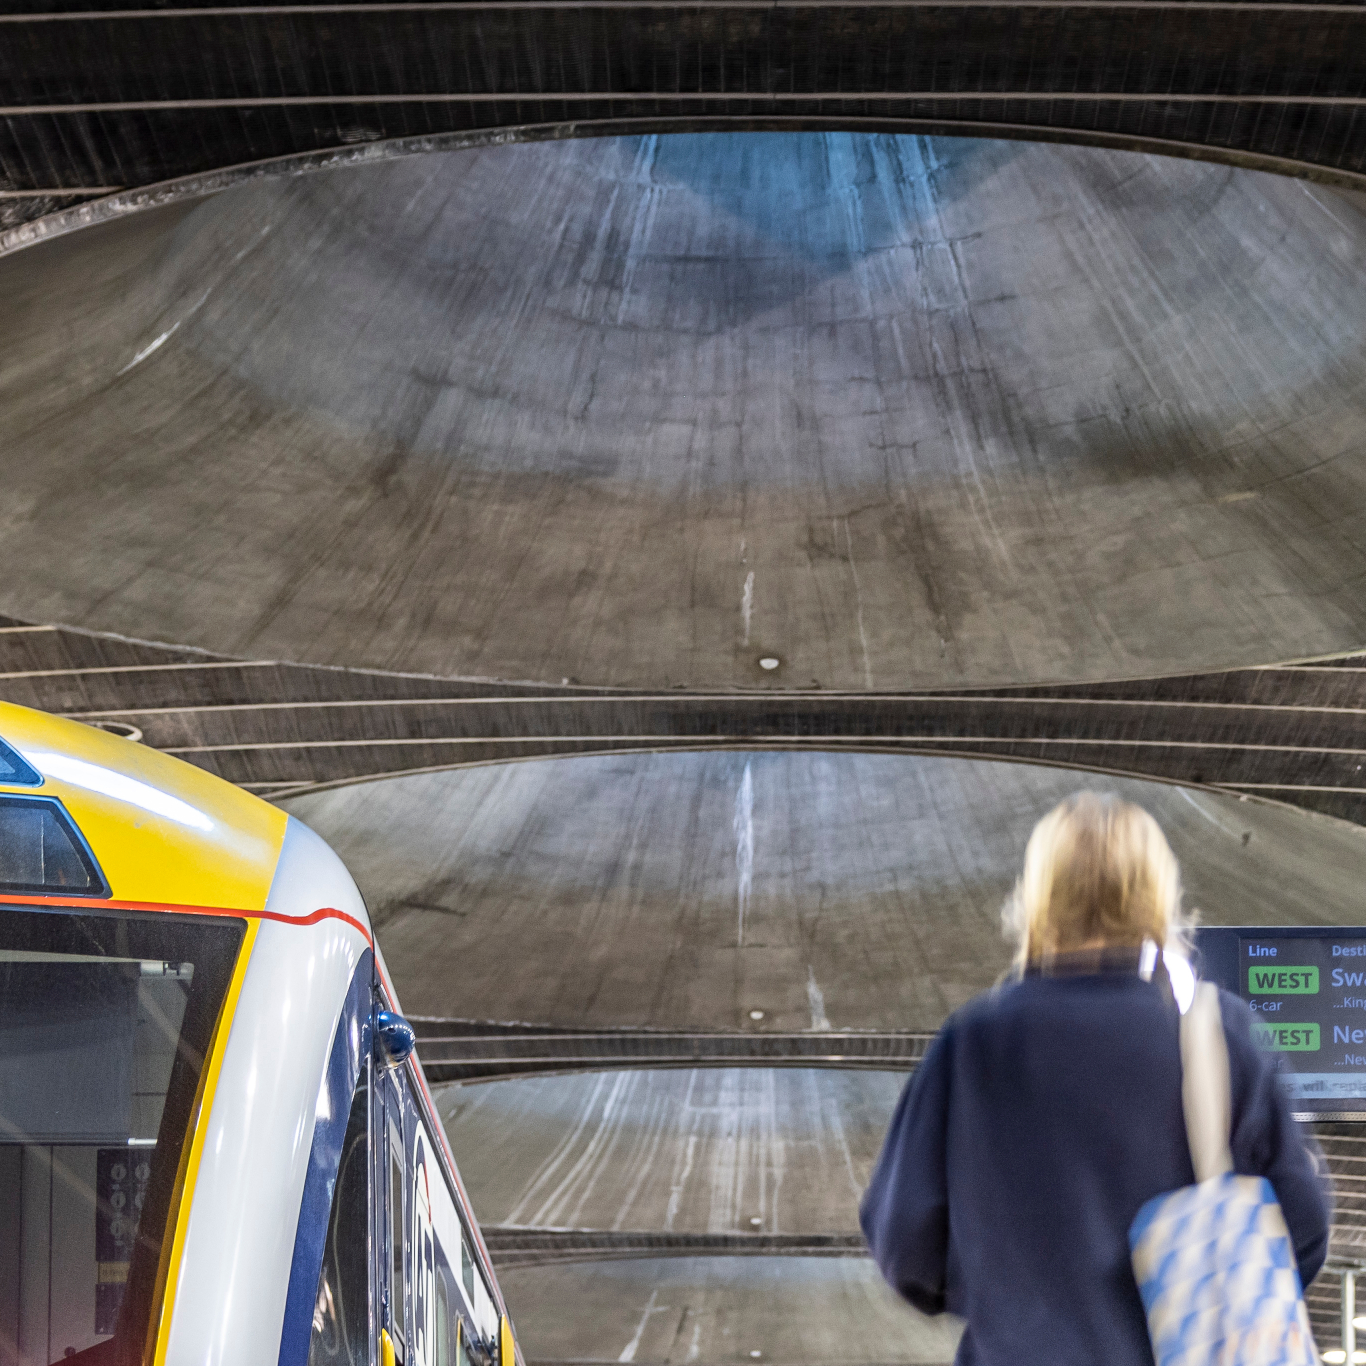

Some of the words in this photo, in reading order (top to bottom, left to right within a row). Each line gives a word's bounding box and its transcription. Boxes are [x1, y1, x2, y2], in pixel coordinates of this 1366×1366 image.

[1248, 945, 1278, 957] Line
[1255, 972, 1313, 989] WEST
[1249, 999, 1283, 1012] 6-car
[1256, 1029, 1314, 1046] WEST
